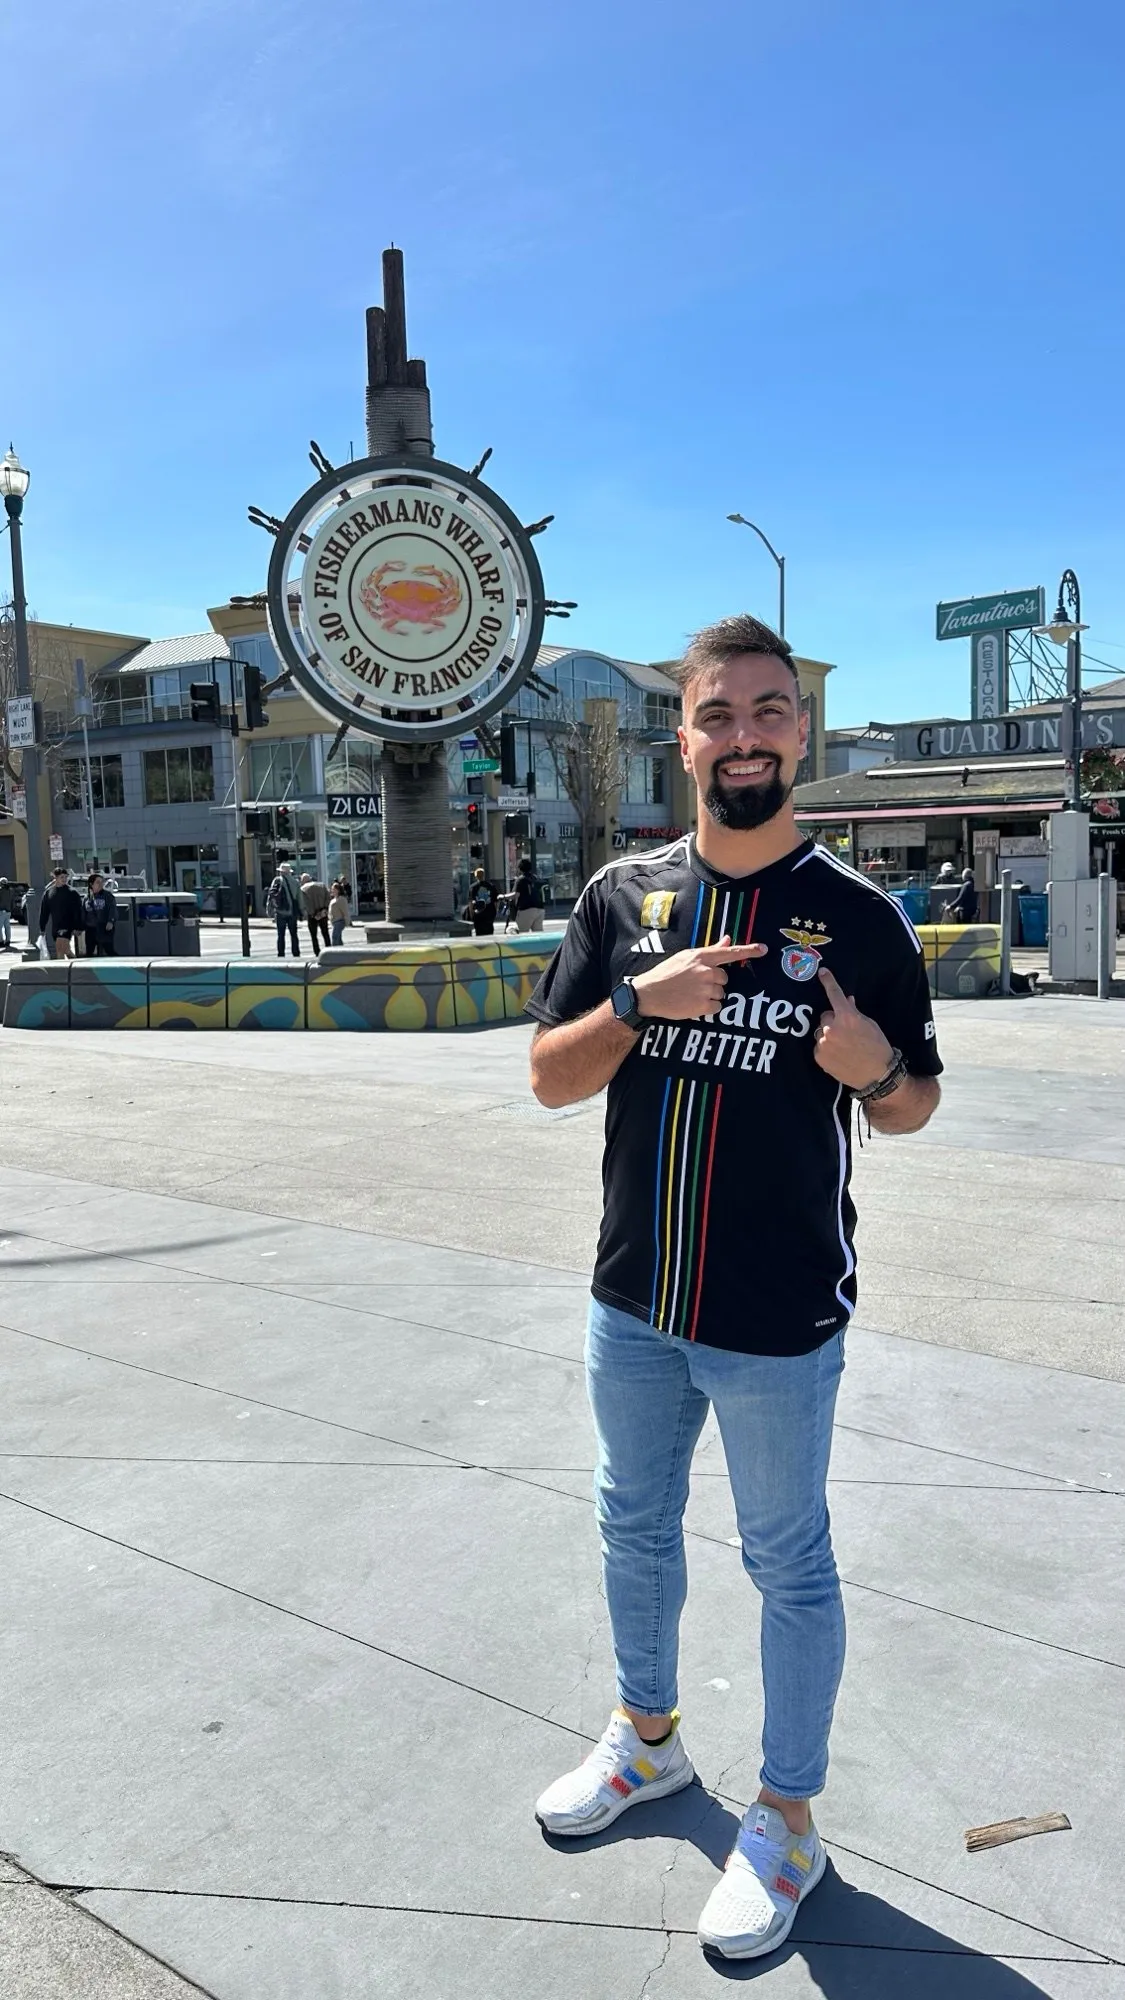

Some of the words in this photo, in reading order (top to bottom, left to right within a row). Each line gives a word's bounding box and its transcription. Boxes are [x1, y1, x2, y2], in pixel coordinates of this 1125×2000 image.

[314, 498, 444, 600] FISHERMANS
[445, 512, 504, 604] WHARF
[940, 598, 1038, 634] Tarantino's
[319, 612, 350, 642] OF
[340, 646, 388, 688] SAN
[391, 615, 501, 697] FRANCISCO
[13, 717, 27, 728] MUST
[917, 714, 1113, 757] GUARDIN'S
[472, 762, 491, 770] Taylor
[501, 798, 527, 807] Jefferson
[640, 1024, 680, 1060] FLY
[682, 1028, 777, 1075] BETTER
